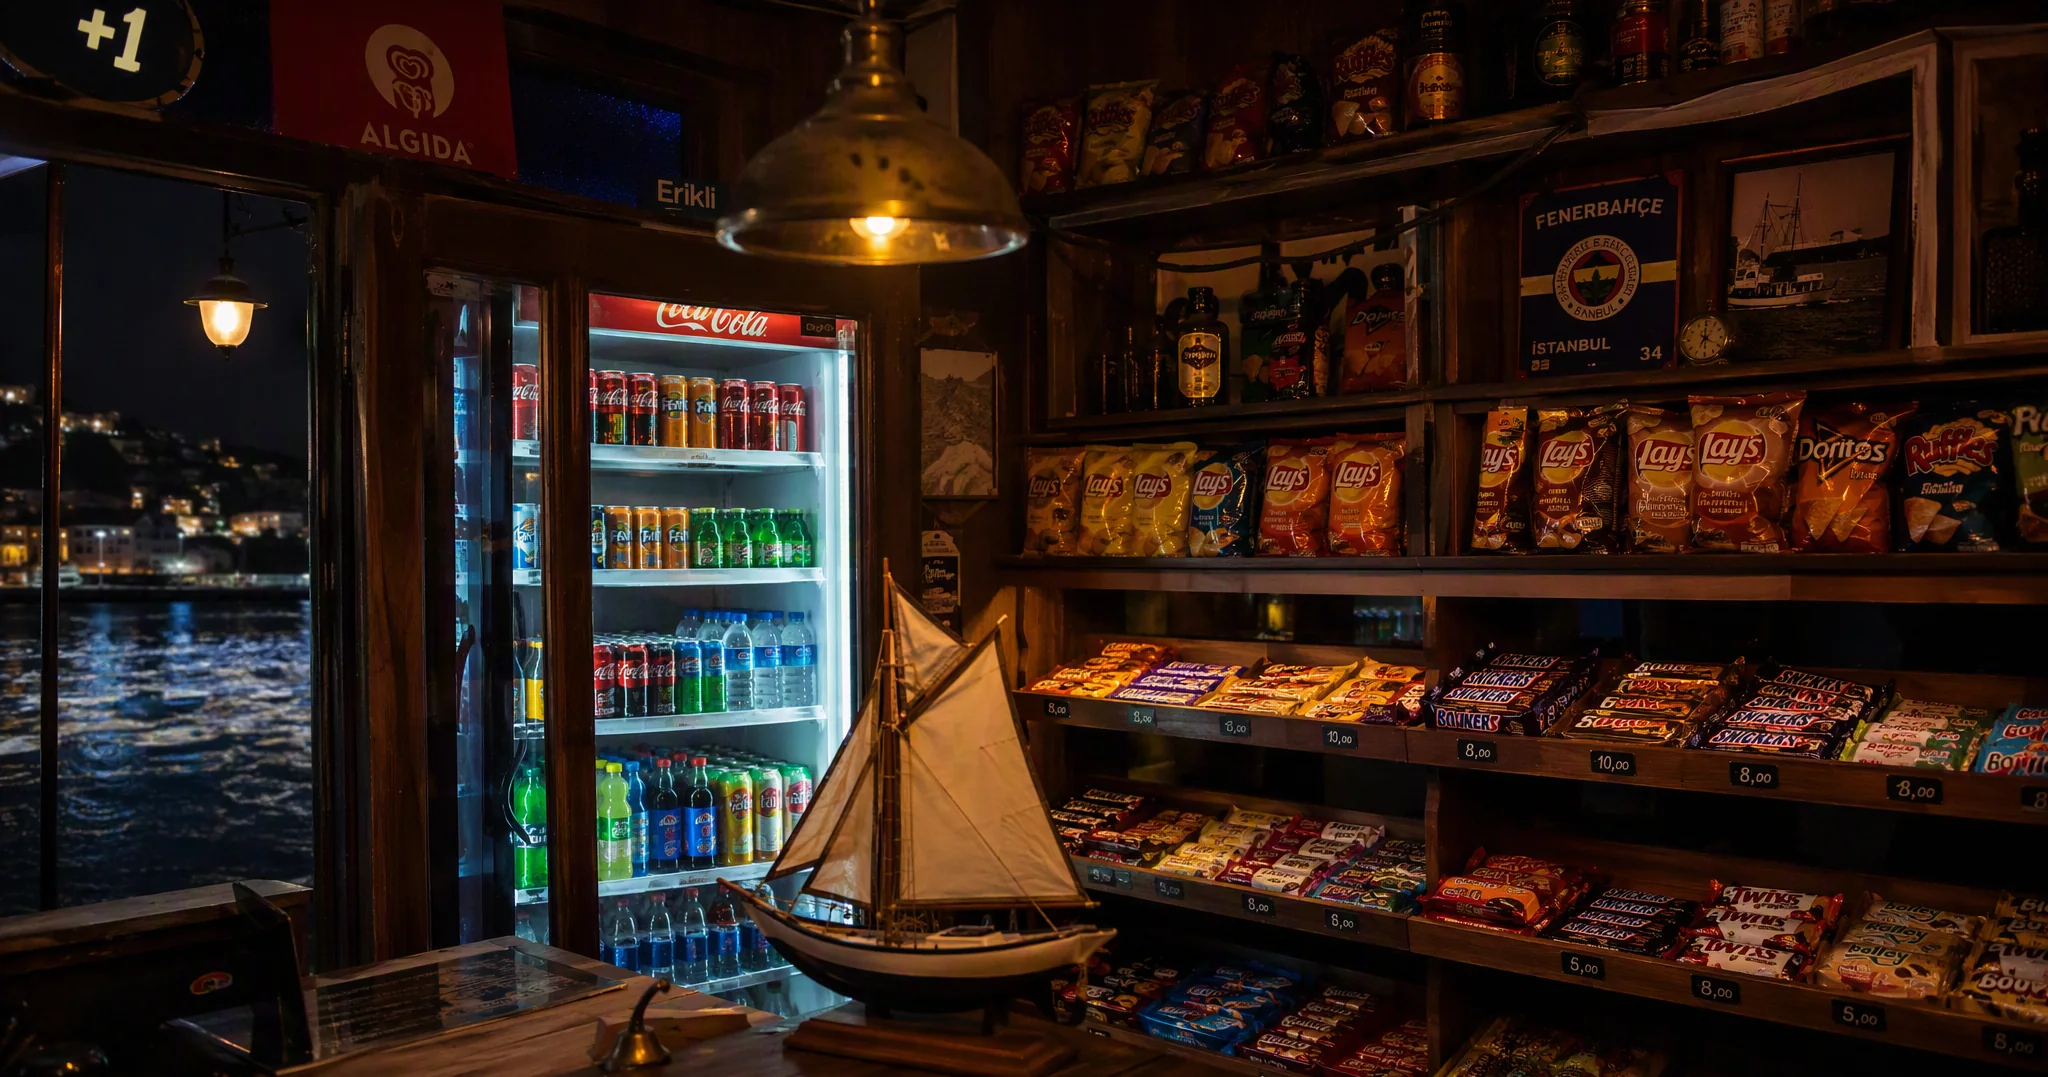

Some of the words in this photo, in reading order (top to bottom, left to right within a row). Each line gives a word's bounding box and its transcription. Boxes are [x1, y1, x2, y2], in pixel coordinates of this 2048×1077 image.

[78, 8, 147, 73] +1
[360, 120, 472, 166] ALGIDA
[657, 179, 716, 210] Erikli
[1535, 198, 1665, 231] FENERBAHÇE
[1639, 345, 1663, 361] 34
[1800, 438, 1887, 463] Doritos
[1904, 427, 2000, 476] Ruffles
[1465, 743, 1491, 759] 8,00
[1597, 755, 1630, 773] 10,00
[1739, 766, 1772, 786] 8,00
[1248, 897, 1270, 913] 8,00
[1700, 980, 1733, 999] 8,00
